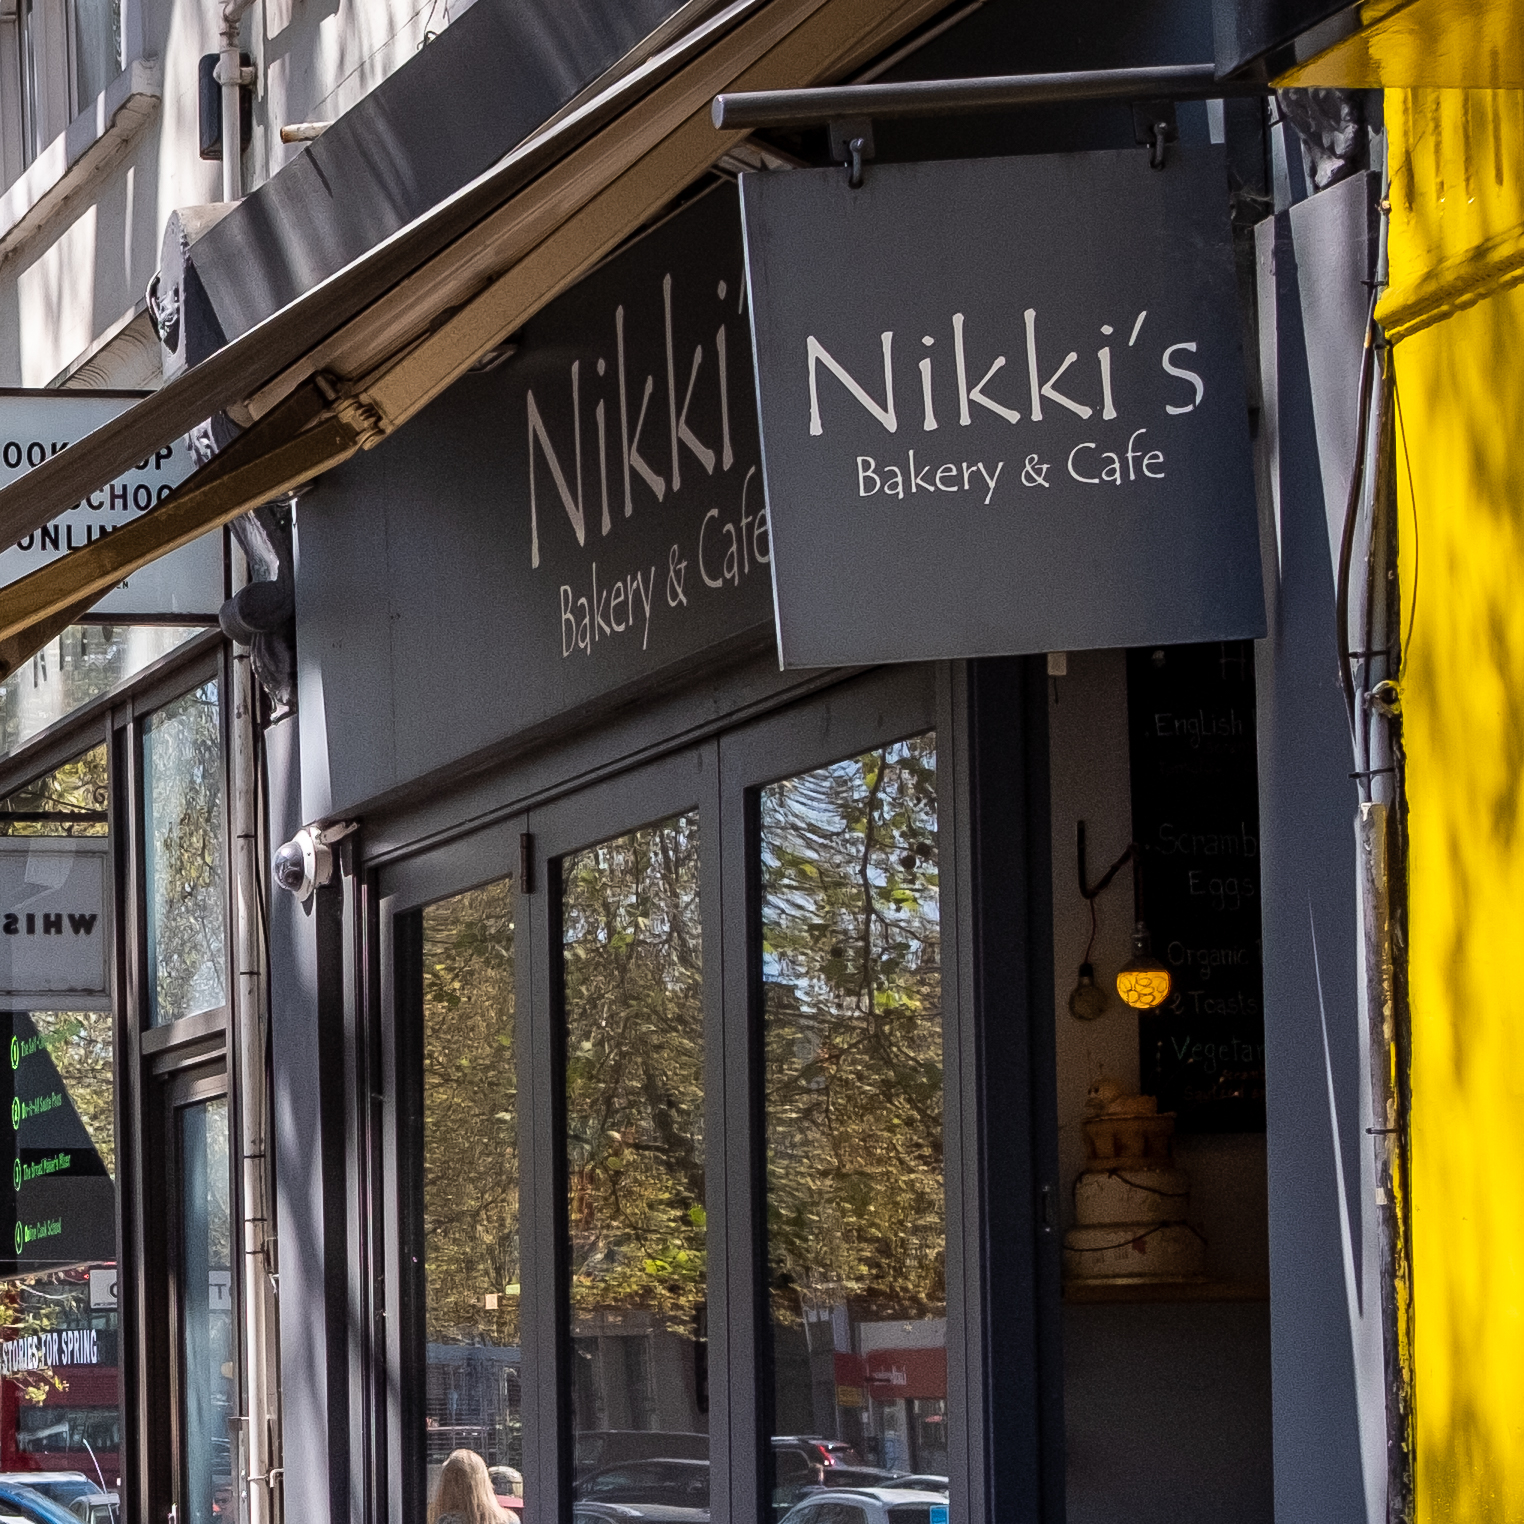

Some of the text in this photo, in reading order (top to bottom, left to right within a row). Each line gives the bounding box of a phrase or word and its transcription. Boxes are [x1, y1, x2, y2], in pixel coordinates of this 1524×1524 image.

[807, 308, 1205, 437] Nikki's
[527, 266, 746, 570] Nikki'
[857, 428, 1166, 505] Bakery & Cafe
[68, 484, 175, 512] CHOO
[16, 524, 120, 552] ONLIN
[559, 464, 770, 660] Bakery & Cafe
[1158, 821, 1258, 858] Scramb
[1188, 869, 1256, 911] Eggs
[1170, 1034, 1264, 1075] Vegetar
[1, 1335, 39, 1376] STORIES
[41, 1331, 59, 1367] FOR
[61, 1328, 98, 1366] SPRING
